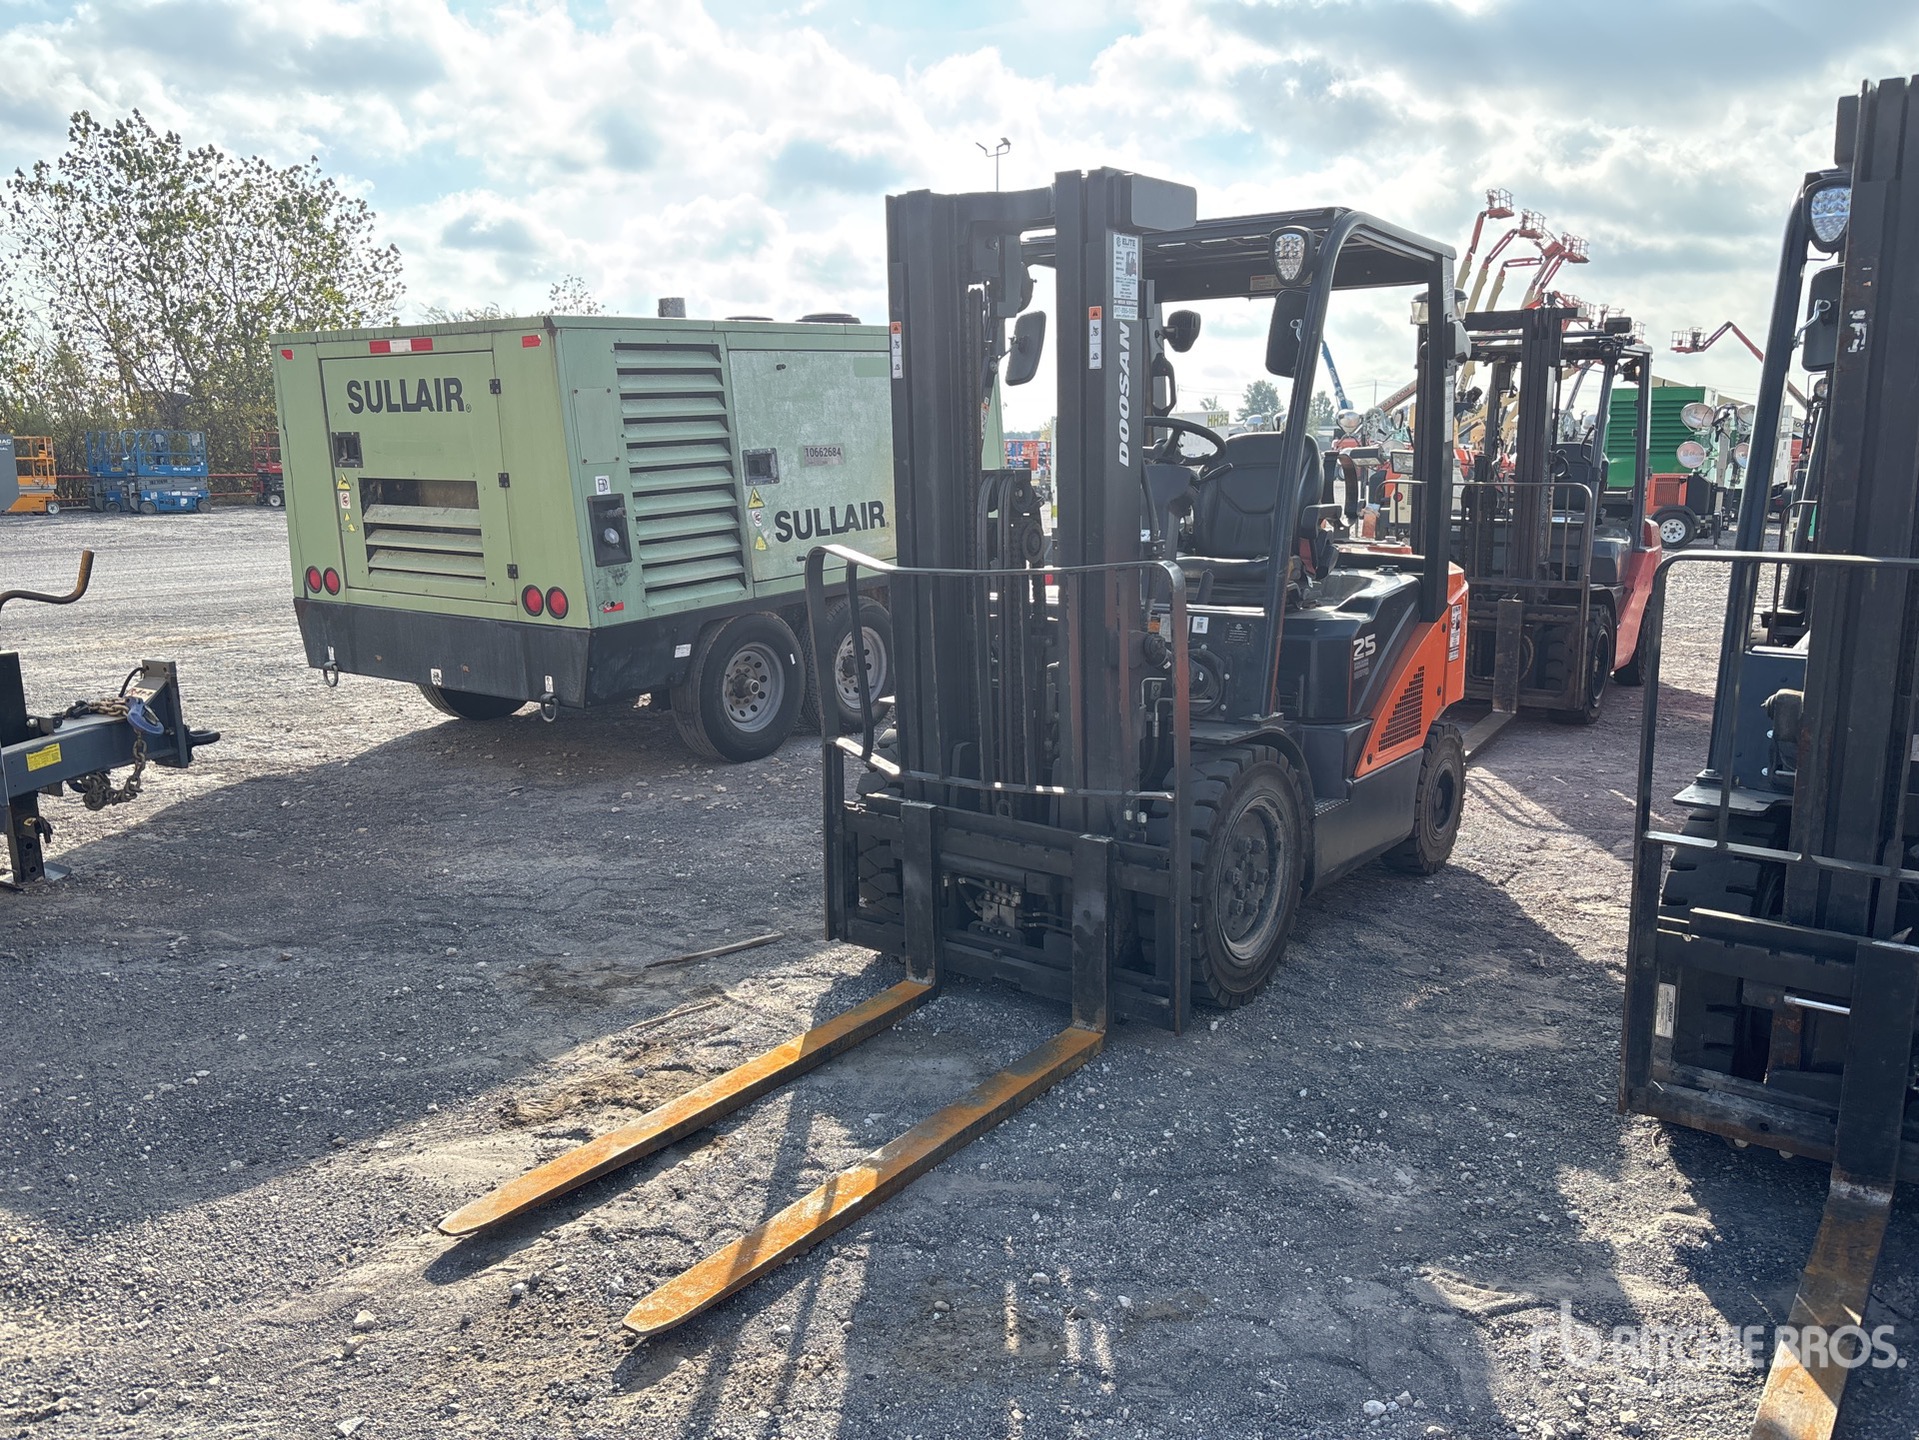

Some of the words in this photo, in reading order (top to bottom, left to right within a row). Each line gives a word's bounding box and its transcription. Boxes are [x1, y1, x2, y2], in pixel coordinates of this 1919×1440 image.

[346, 377, 465, 415] SULLAIR
[1119, 321, 1130, 467] DOOSAN
[805, 447, 842, 458] 10662684
[774, 501, 886, 543] SULLAIR
[1353, 633, 1376, 661] 25
